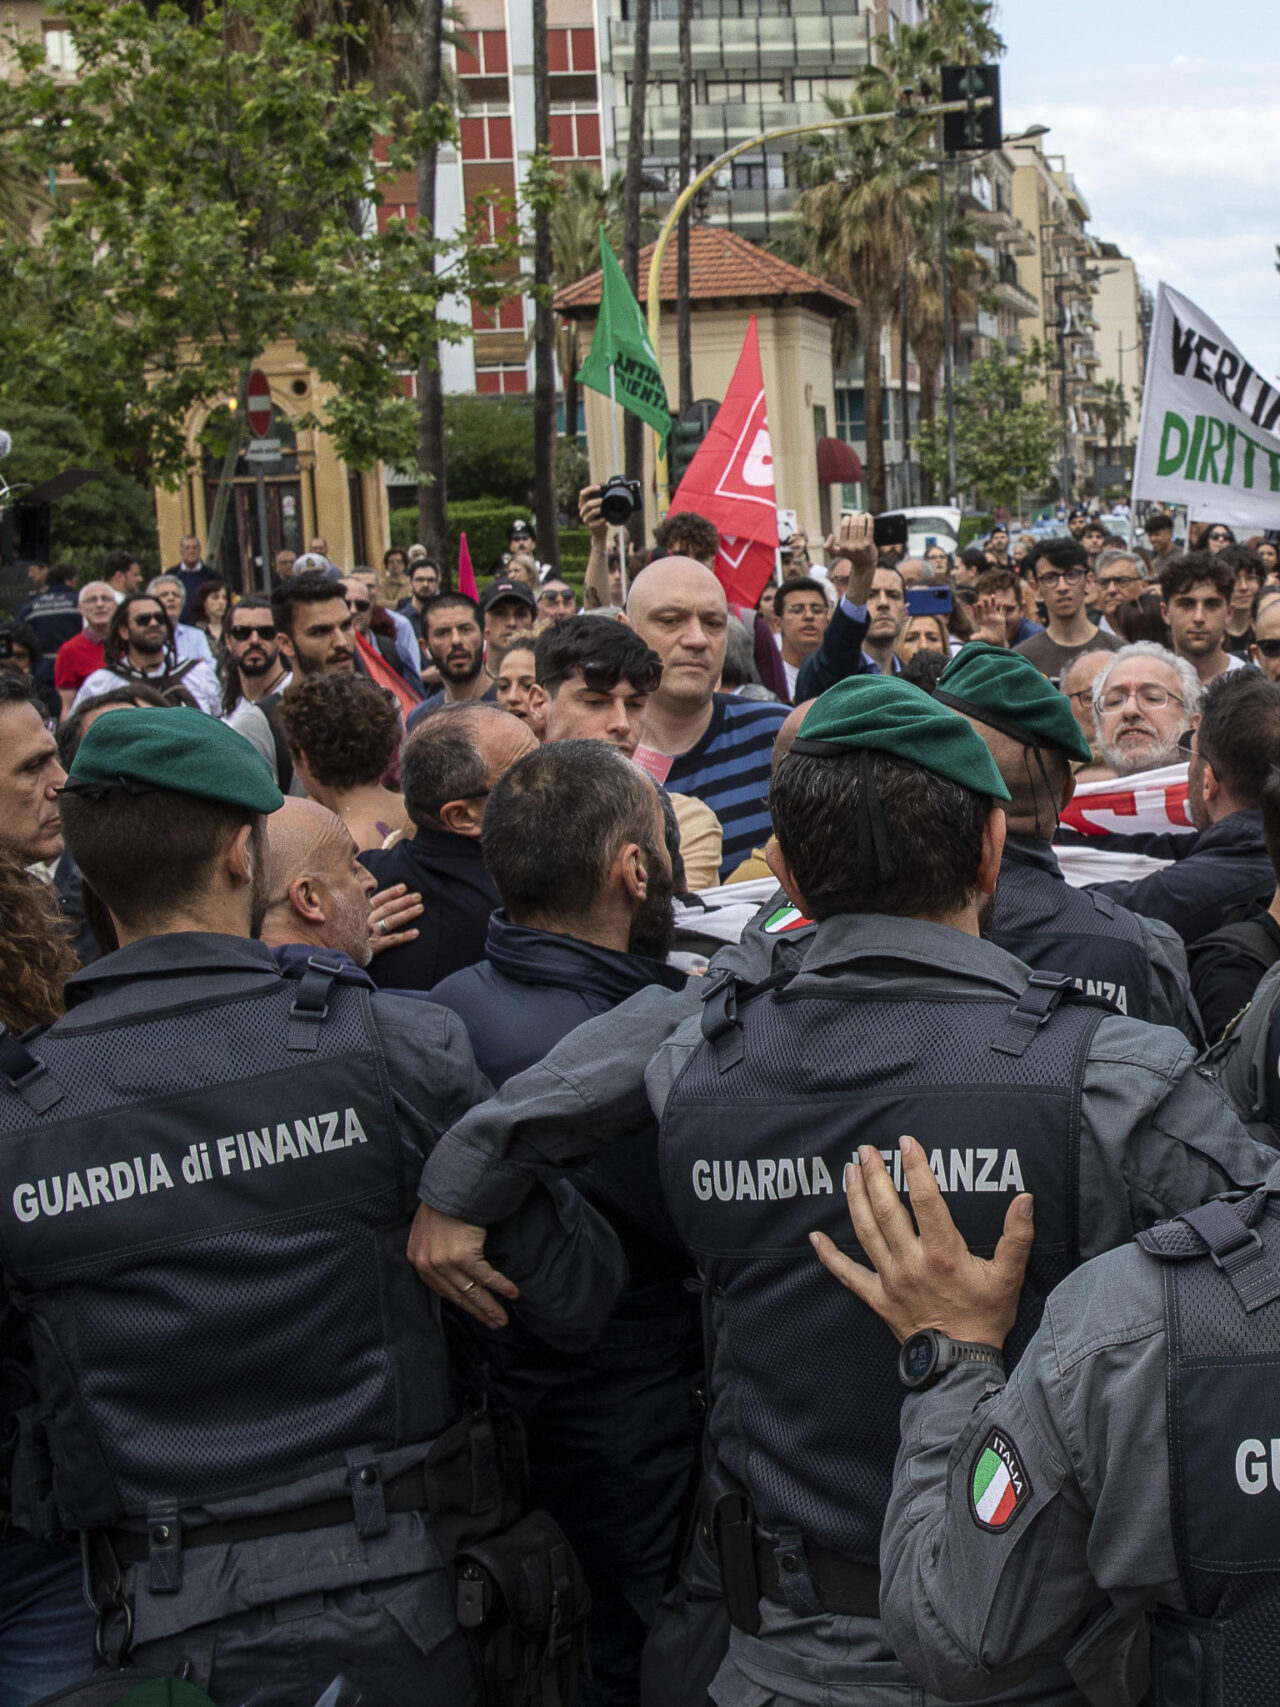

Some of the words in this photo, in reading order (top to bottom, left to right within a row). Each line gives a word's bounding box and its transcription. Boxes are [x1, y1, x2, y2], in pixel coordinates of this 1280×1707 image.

[1074, 977, 1128, 1016] ANZA
[12, 1151, 181, 1223] GUARDIA
[181, 1144, 213, 1184] di
[217, 1107, 368, 1176] FINANZA
[691, 1155, 834, 1202] GUARDIA
[884, 1148, 1025, 1193] IANZA
[993, 1436, 1023, 1496] ITALIA
